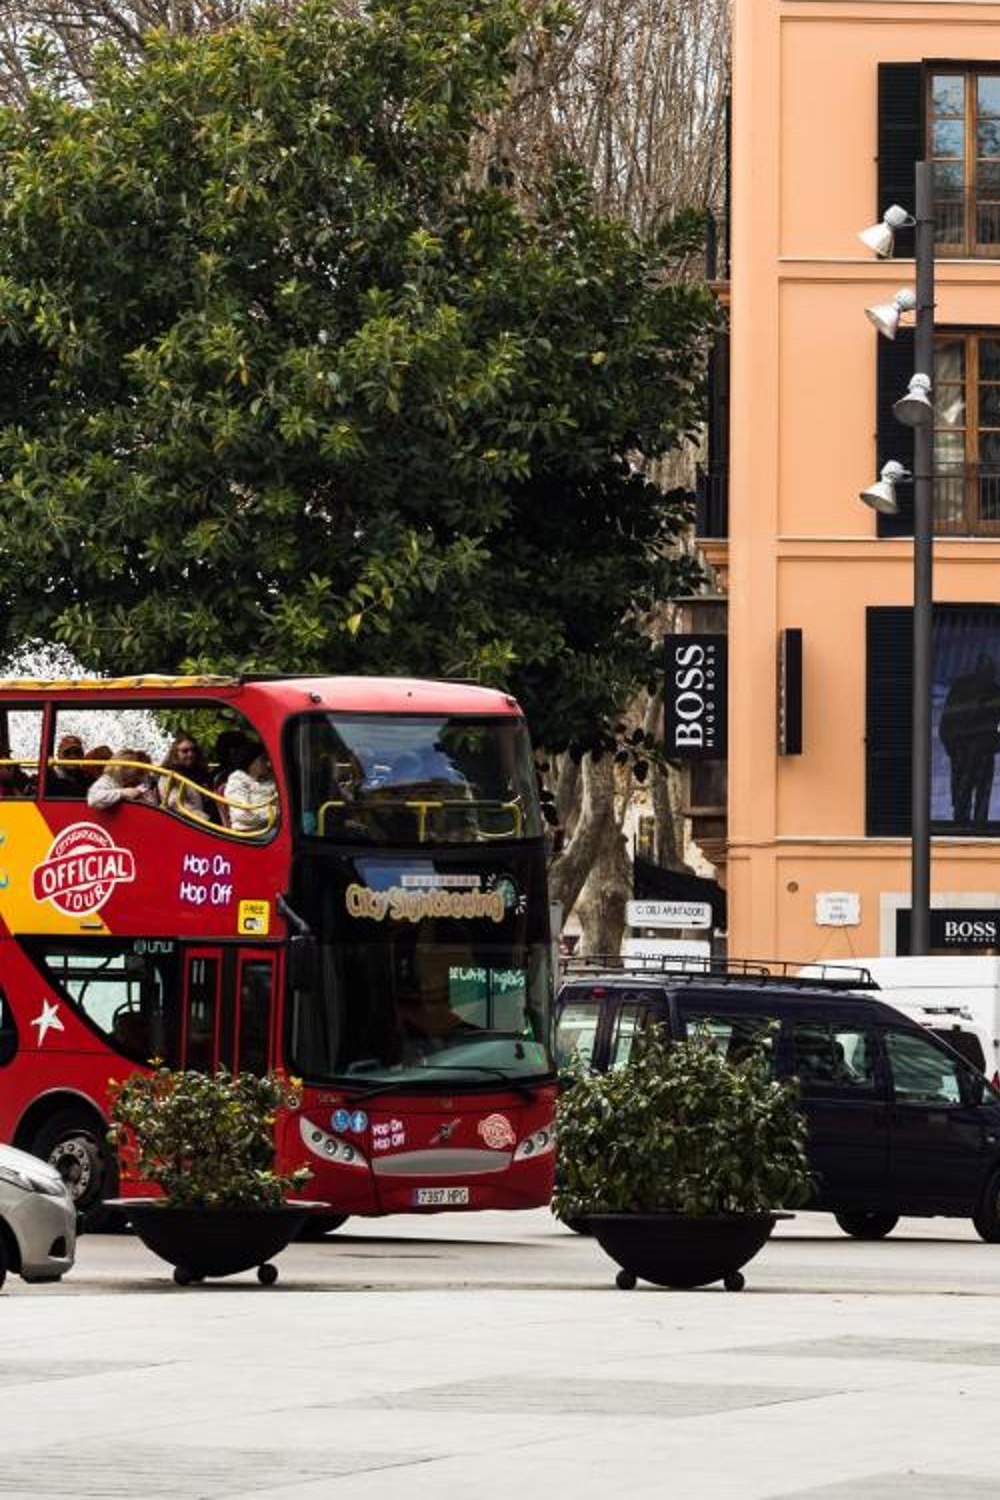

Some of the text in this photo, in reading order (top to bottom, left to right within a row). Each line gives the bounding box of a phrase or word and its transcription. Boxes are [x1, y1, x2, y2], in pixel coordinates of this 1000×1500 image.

[675, 644, 705, 748] BOSS
[706, 645, 715, 747] HUGO BOSS
[41, 855, 127, 893] OFFICIAL
[183, 855, 231, 876] Hop On
[65, 883, 105, 910] TOUR
[179, 882, 233, 905] Hop Off
[346, 884, 504, 923] City Sightseeing
[944, 921, 997, 937] BOSS
